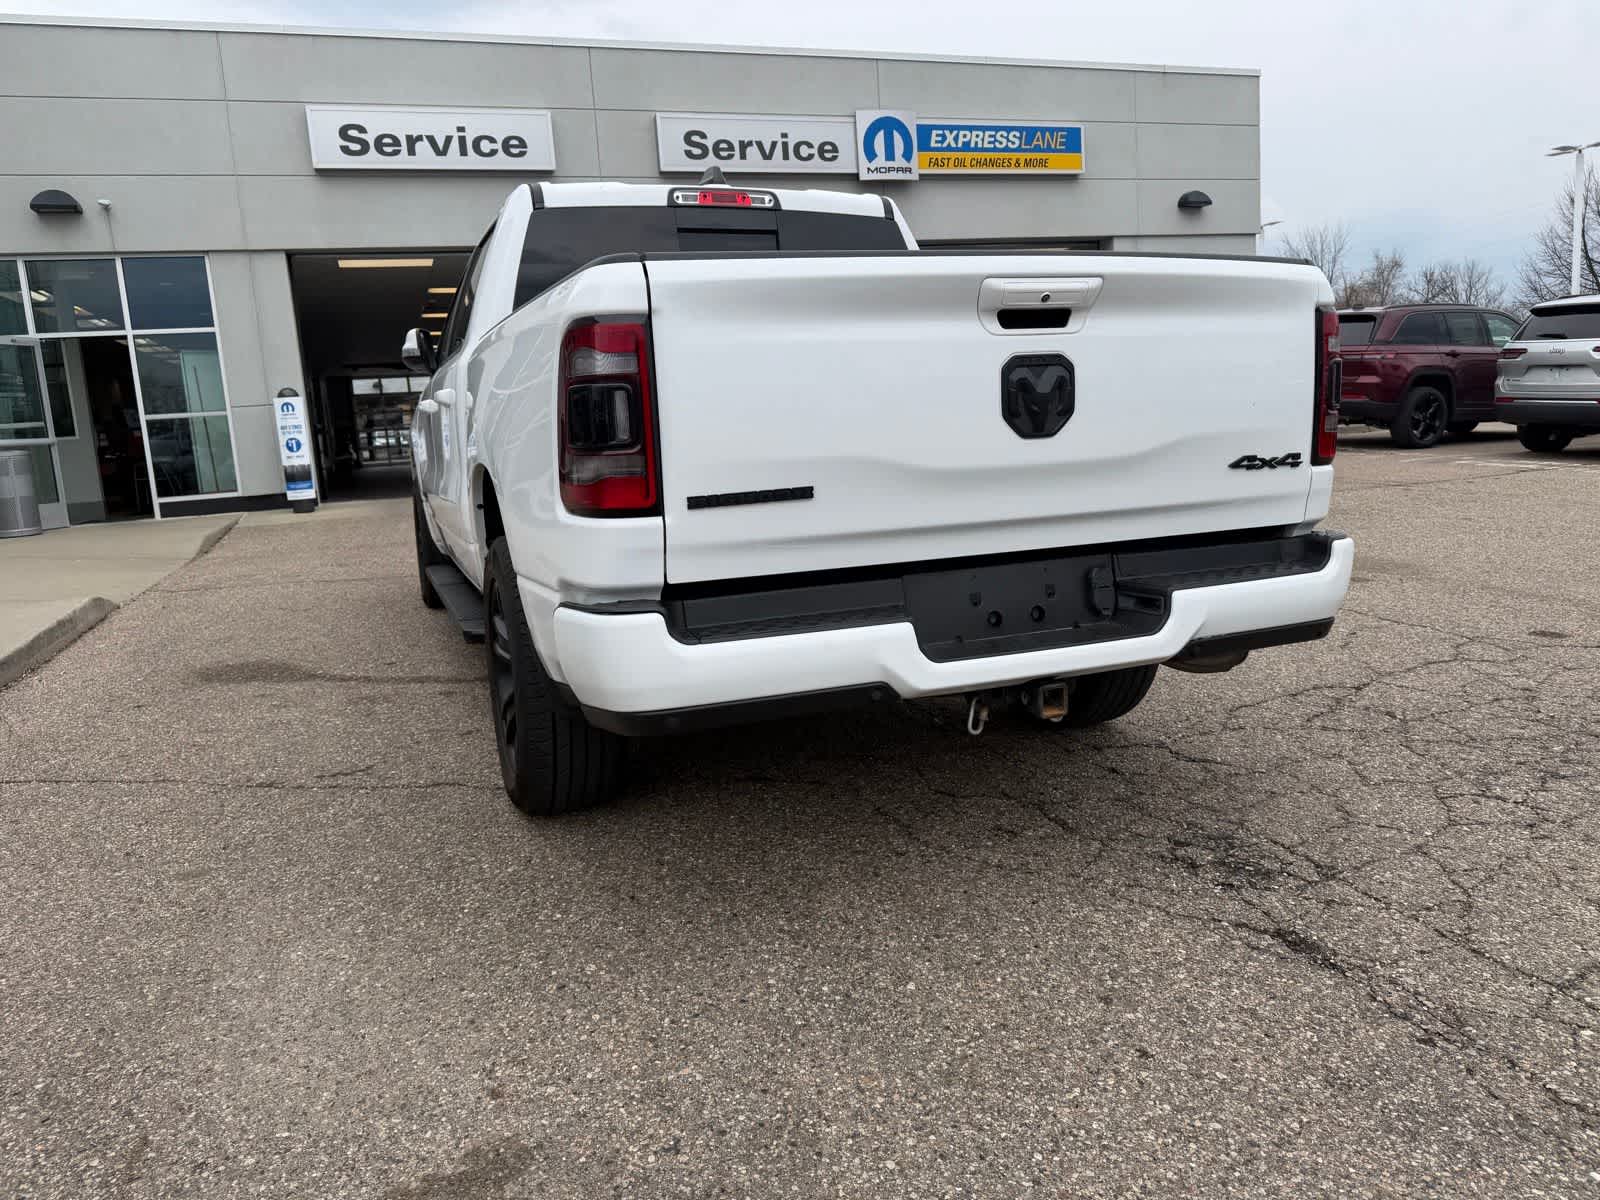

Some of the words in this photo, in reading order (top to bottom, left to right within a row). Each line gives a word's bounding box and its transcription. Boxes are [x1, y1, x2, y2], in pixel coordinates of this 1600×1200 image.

[338, 123, 528, 158] Service
[682, 129, 840, 162] Service
[930, 129, 1068, 149] EXPRESSLANE
[928, 157, 950, 168] FAST
[953, 157, 968, 168] OIL
[969, 157, 1013, 169] CHANGES
[1015, 158, 1022, 168] &
[1023, 158, 1049, 168] MORE
[1228, 452, 1303, 471] 4x4
